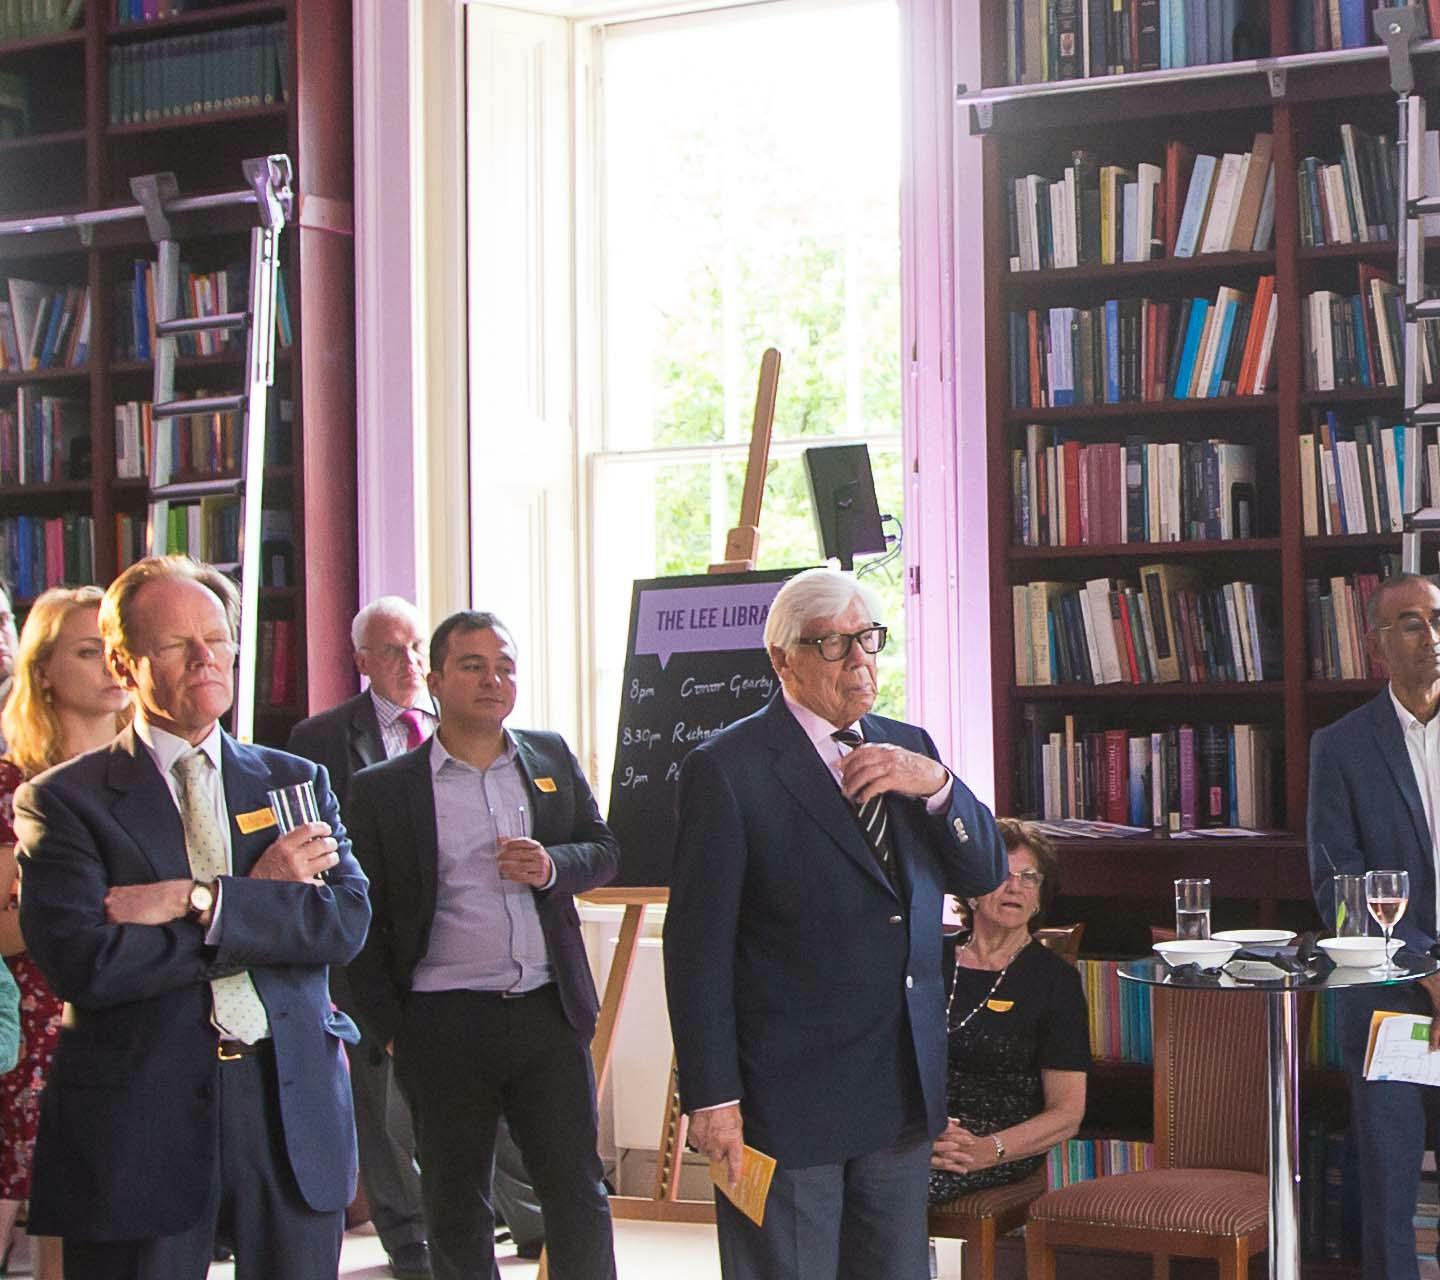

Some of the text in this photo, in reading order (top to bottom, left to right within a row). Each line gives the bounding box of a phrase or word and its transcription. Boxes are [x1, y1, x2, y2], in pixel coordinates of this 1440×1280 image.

[657, 609, 684, 631] THE
[690, 608, 718, 628] LEE
[630, 678, 655, 704] 8pm
[621, 766, 648, 789] 9pm
